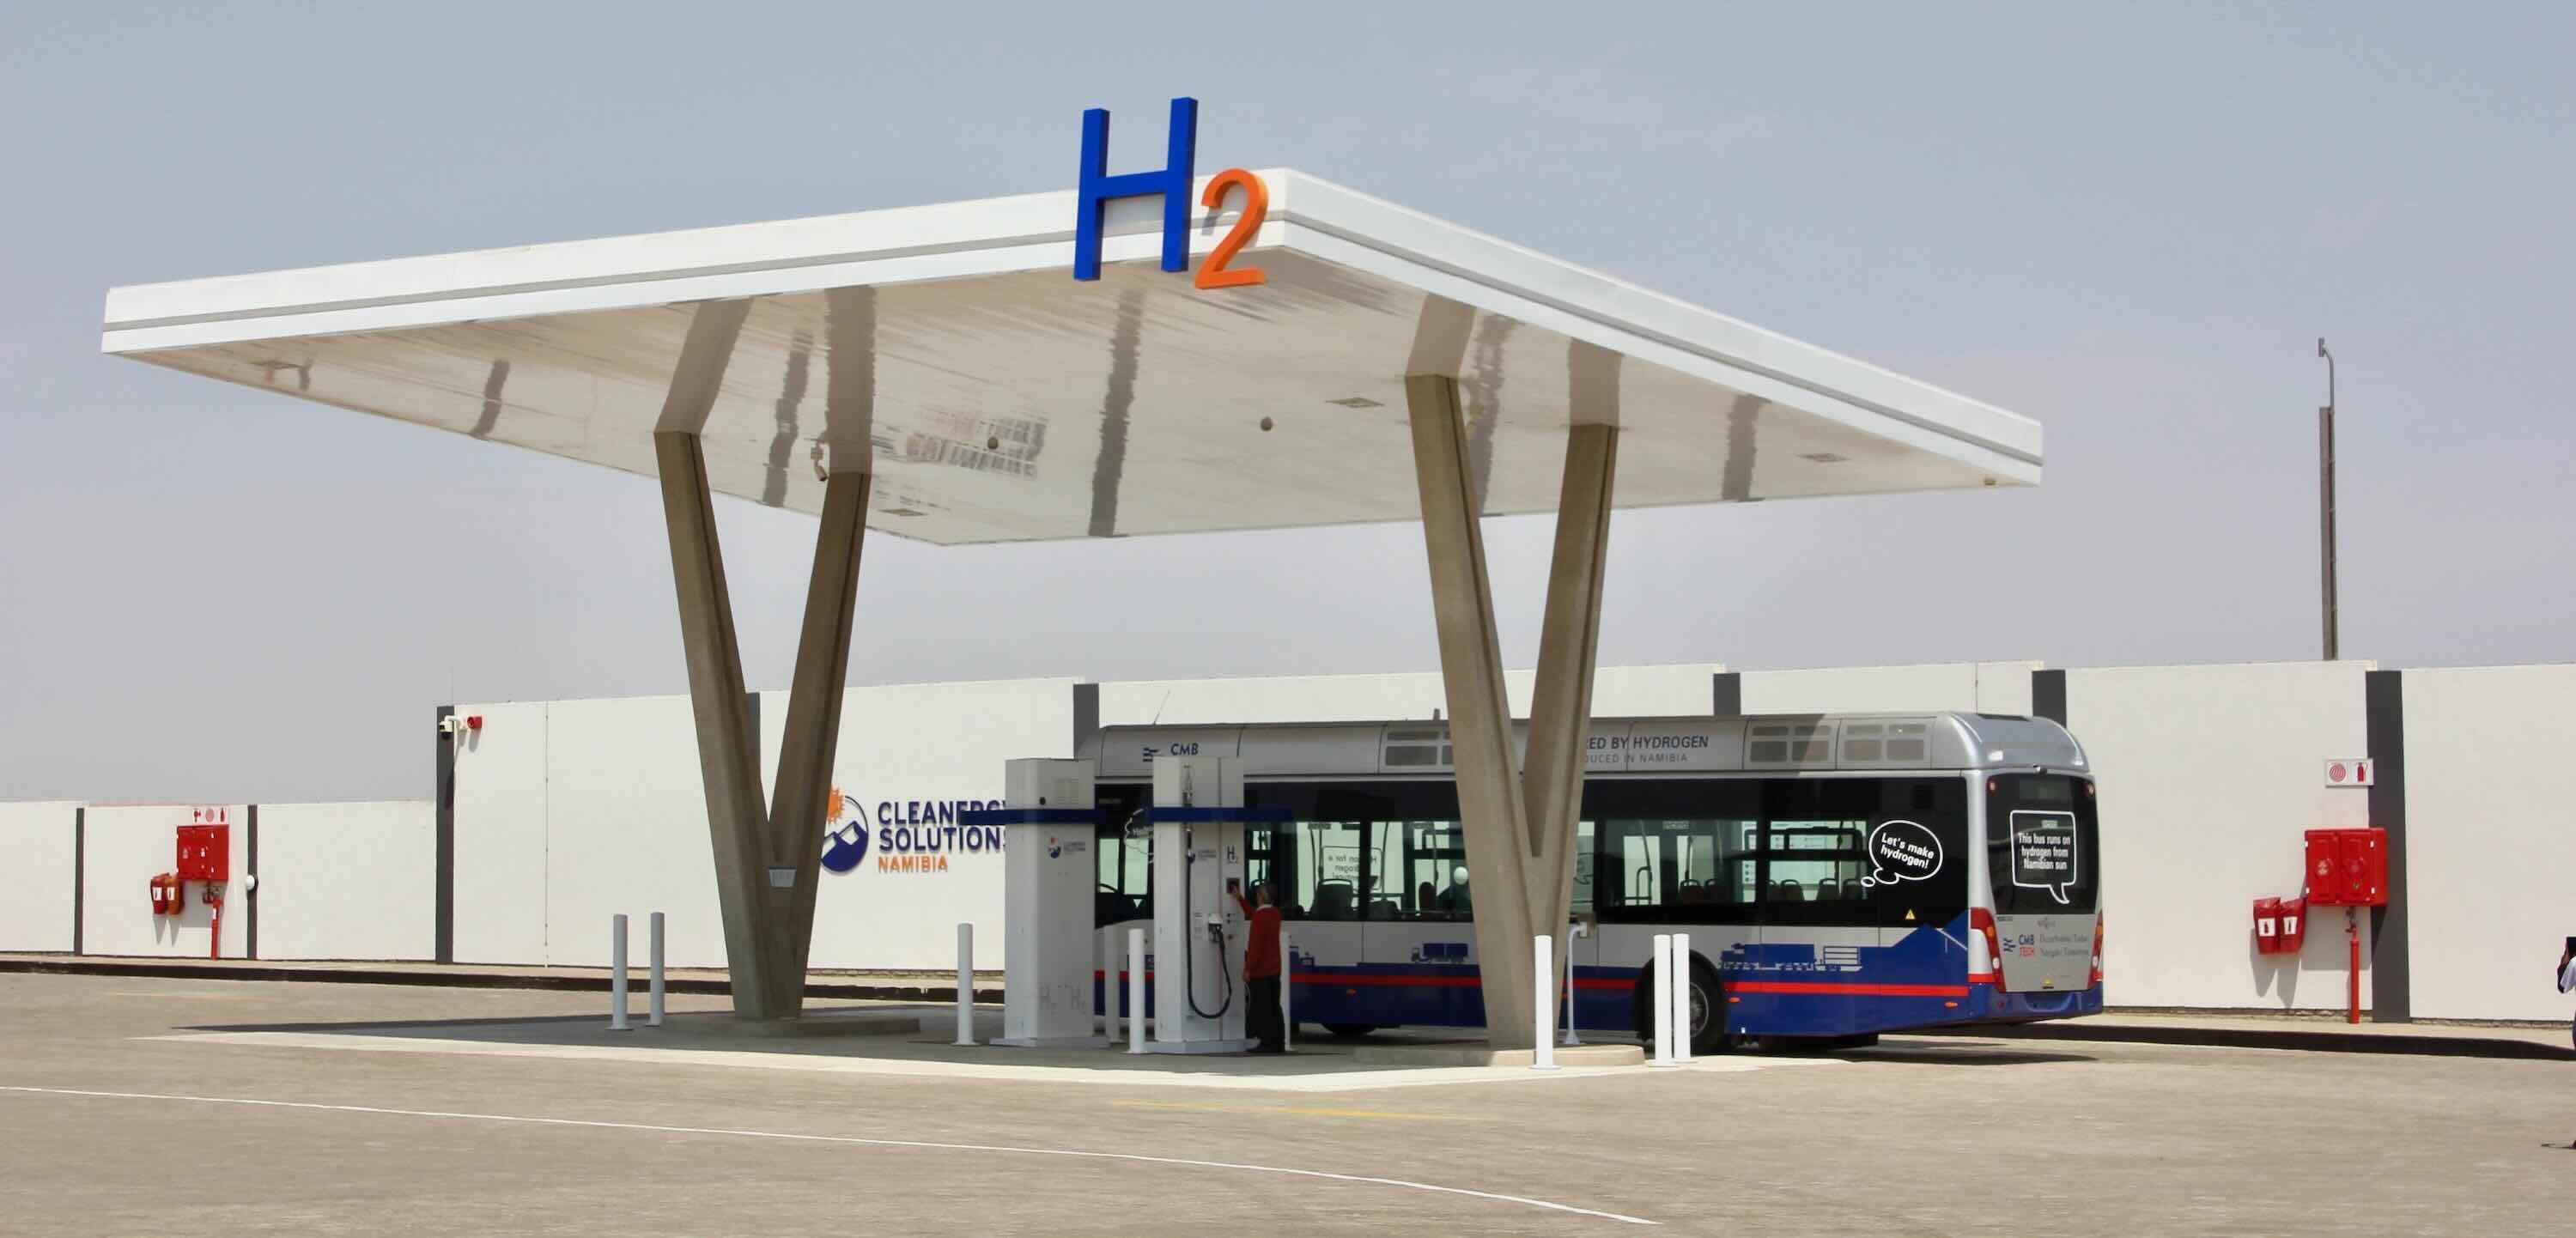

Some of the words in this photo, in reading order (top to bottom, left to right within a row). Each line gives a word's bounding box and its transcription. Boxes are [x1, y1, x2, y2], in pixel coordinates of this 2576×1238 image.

[1073, 96, 1268, 289] H2
[1587, 737, 1607, 749] ED
[1611, 737, 1629, 749] BY
[1633, 735, 1709, 749] HYDROGEN
[1170, 743, 1199, 756] CMB
[1624, 754, 1634, 762] IN
[1640, 753, 1688, 762] NAMIBIA
[879, 827, 1005, 853] SOLUTION
[1881, 832, 1905, 849] Let's
[1907, 844, 1935, 859] make
[2018, 832, 2032, 844] This
[2032, 833, 2045, 845] bus
[2046, 835, 2061, 845] runs
[2062, 836, 2071, 846] on
[1880, 844, 1929, 869] hydrogen!
[2020, 845, 2052, 859] hydrogen
[2052, 846, 2069, 858] from
[878, 856, 948, 873] NAMIBIA
[2024, 857, 2054, 870] Namibian
